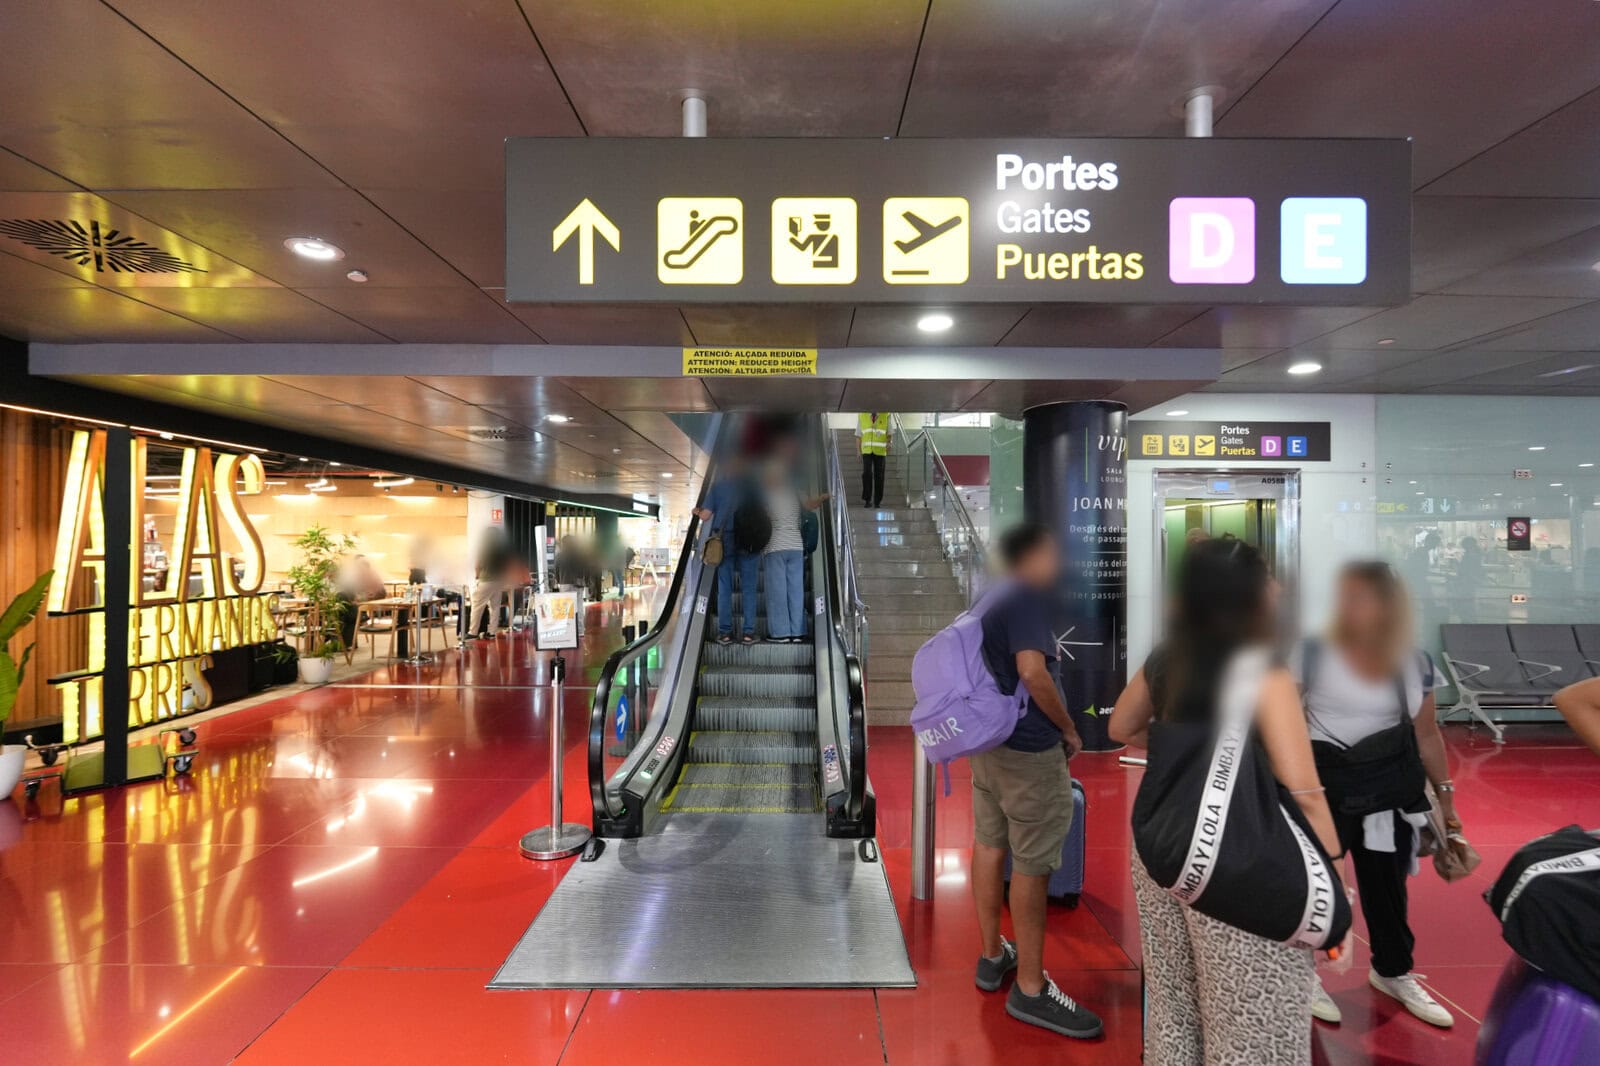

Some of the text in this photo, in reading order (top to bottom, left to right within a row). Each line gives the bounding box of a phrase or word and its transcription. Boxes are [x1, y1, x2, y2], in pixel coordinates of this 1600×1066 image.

[996, 153, 1120, 192] Portes
[997, 201, 1092, 234] Gates
[1189, 212, 1343, 269] D E
[996, 244, 1145, 280] Puertas
[735, 350, 768, 359] ALÇADA
[1098, 428, 1127, 461] vip
[1221, 425, 1250, 435] Portes
[1221, 437, 1244, 445] Gates
[1265, 440, 1302, 453] D E
[1221, 446, 1256, 456] Puertas
[1072, 497, 1113, 512] JOAN
[89, 594, 280, 672] ERMANOS
[55, 654, 213, 745] TRRES
[1200, 803, 1222, 847] LOLA
[1212, 745, 1236, 791] BIMBA
[1306, 887, 1330, 934] LOLA
